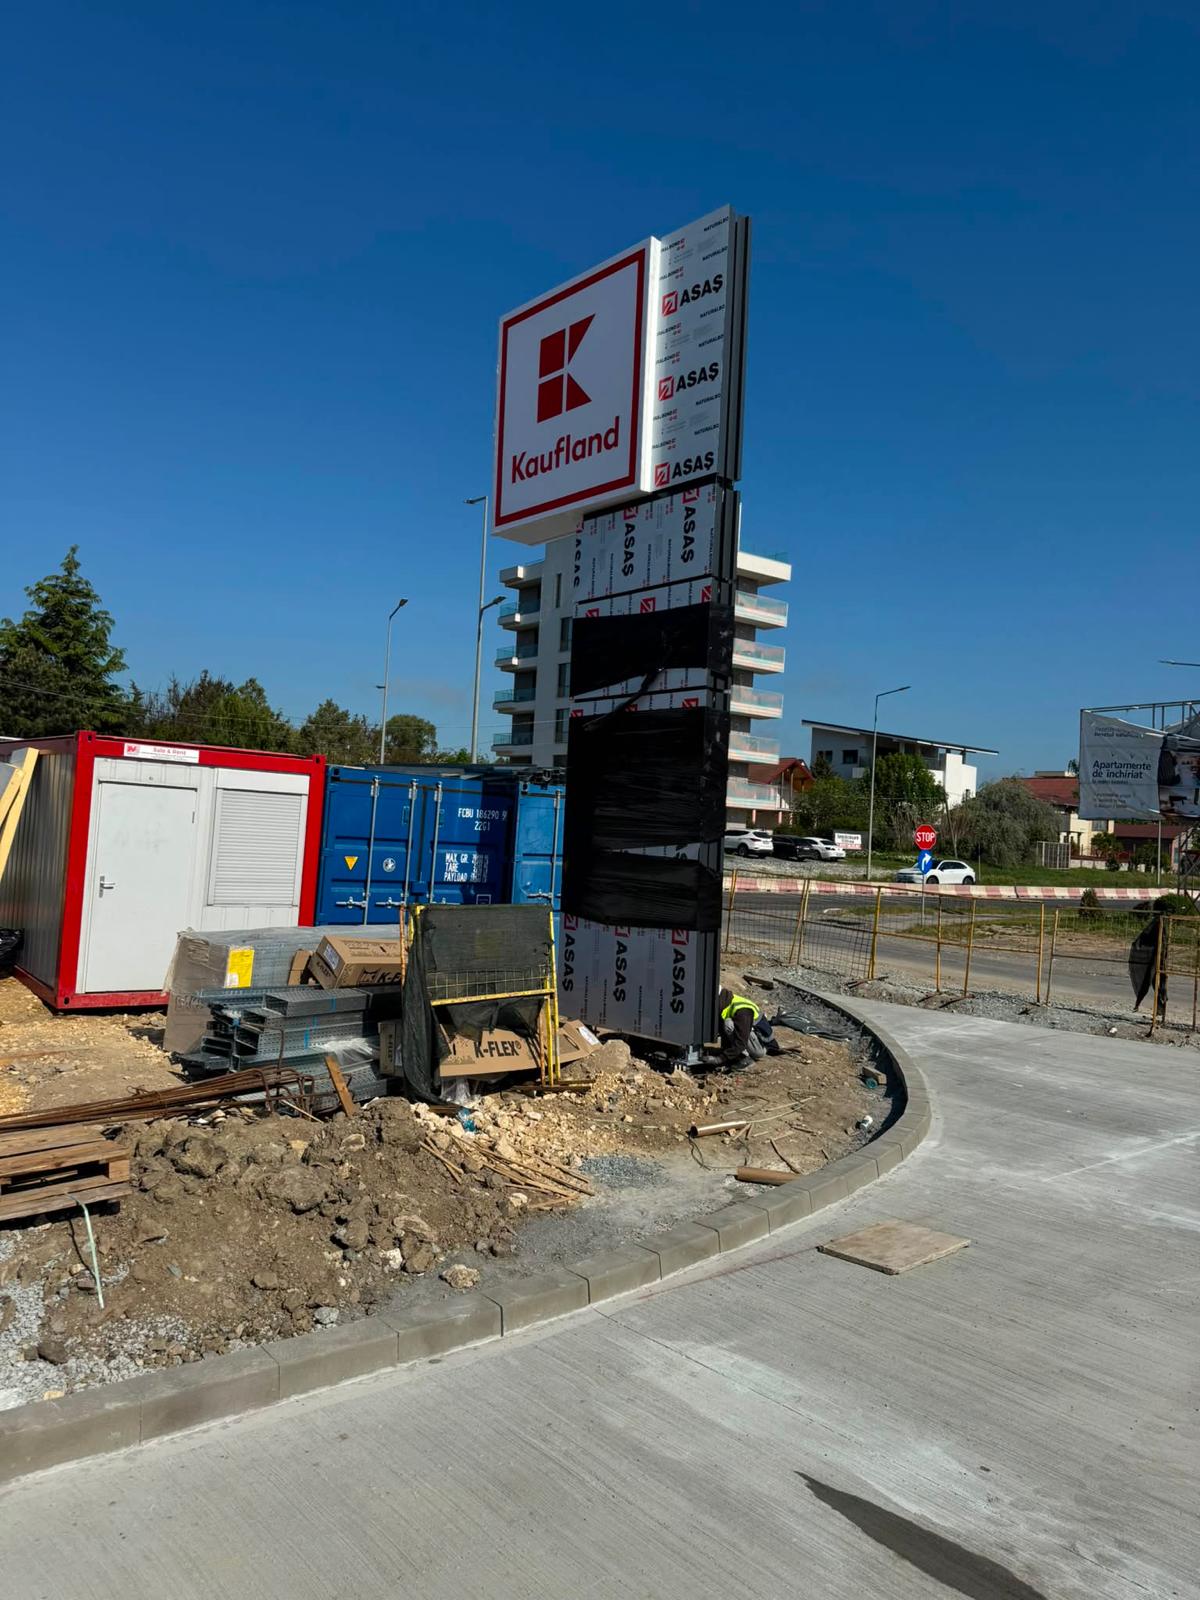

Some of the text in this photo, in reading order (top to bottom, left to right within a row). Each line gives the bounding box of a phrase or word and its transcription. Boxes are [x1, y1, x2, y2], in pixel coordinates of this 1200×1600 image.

[680, 273, 723, 307] ASAŞ
[676, 362, 719, 392] ASAŞ
[511, 415, 620, 484] Kaufland
[672, 451, 714, 479] ASAŞ
[622, 522, 635, 577] ASAŞ
[681, 506, 696, 563] ASAŞ
[1092, 760, 1152, 771] Apartamente
[1092, 769, 1103, 778] de
[916, 832, 935, 842] STOP
[613, 940, 628, 1003] ASAŞ
[669, 948, 686, 1015] ASAŞ
